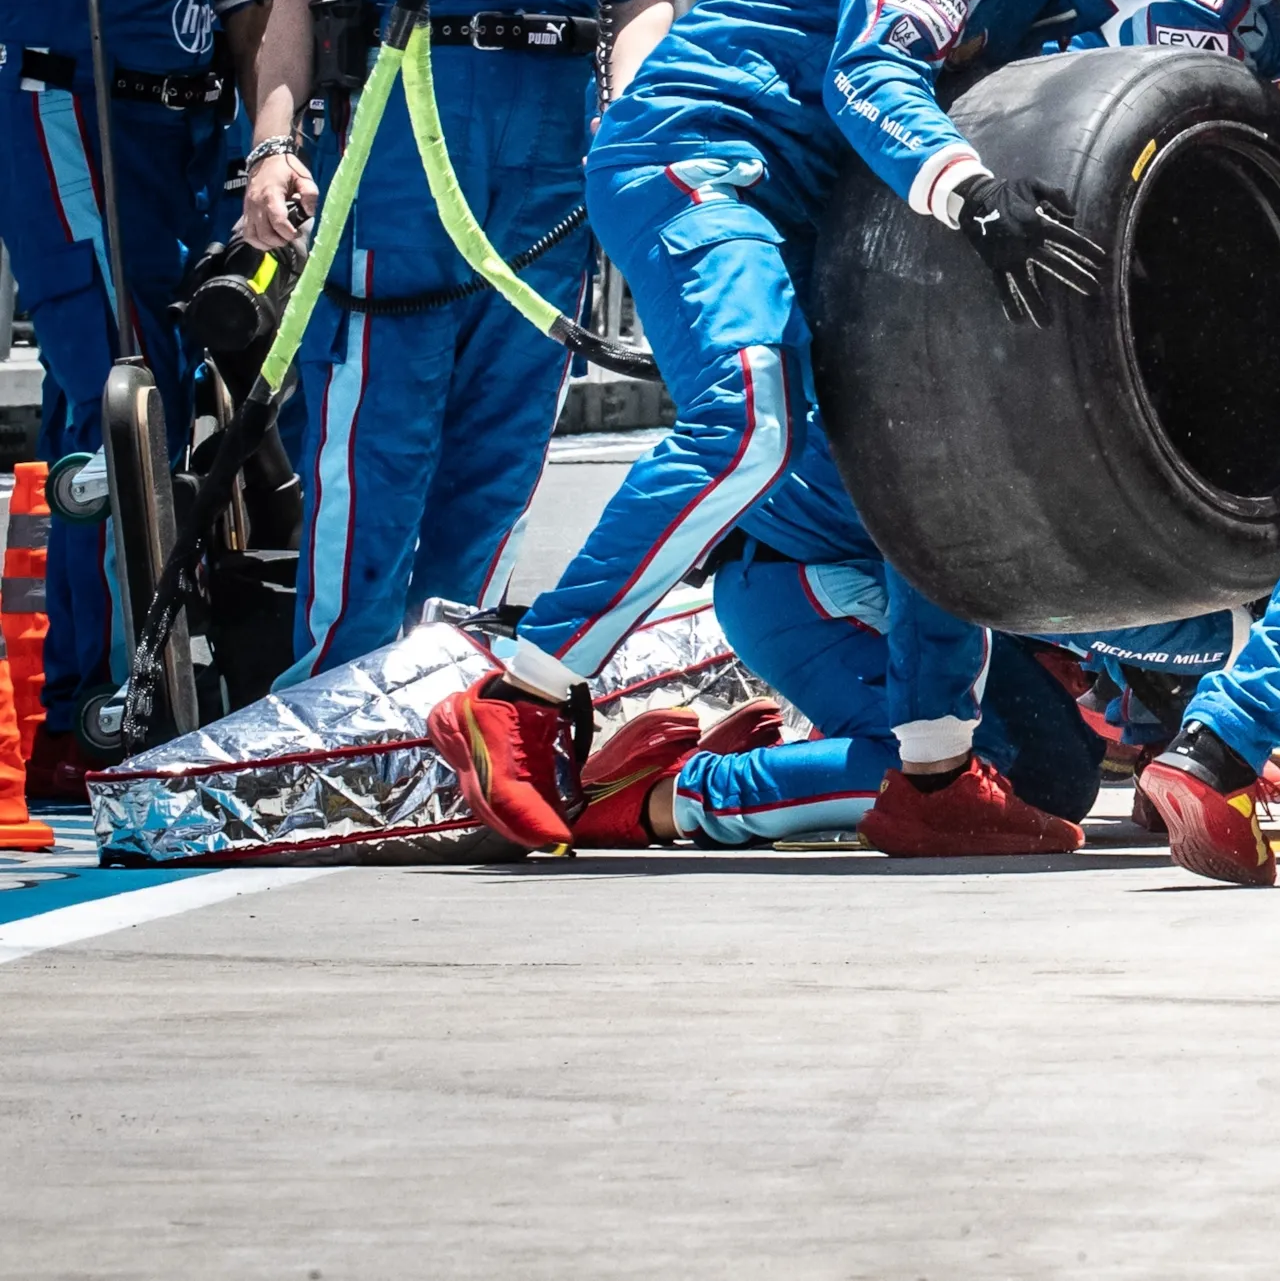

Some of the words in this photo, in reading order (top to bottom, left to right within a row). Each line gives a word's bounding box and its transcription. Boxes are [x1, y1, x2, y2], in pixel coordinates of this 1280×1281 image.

[528, 32, 557, 45] PUMA
[879, 115, 923, 152] MILLE
[1090, 640, 1169, 663] RICHARD
[1172, 651, 1225, 665] MILLE
